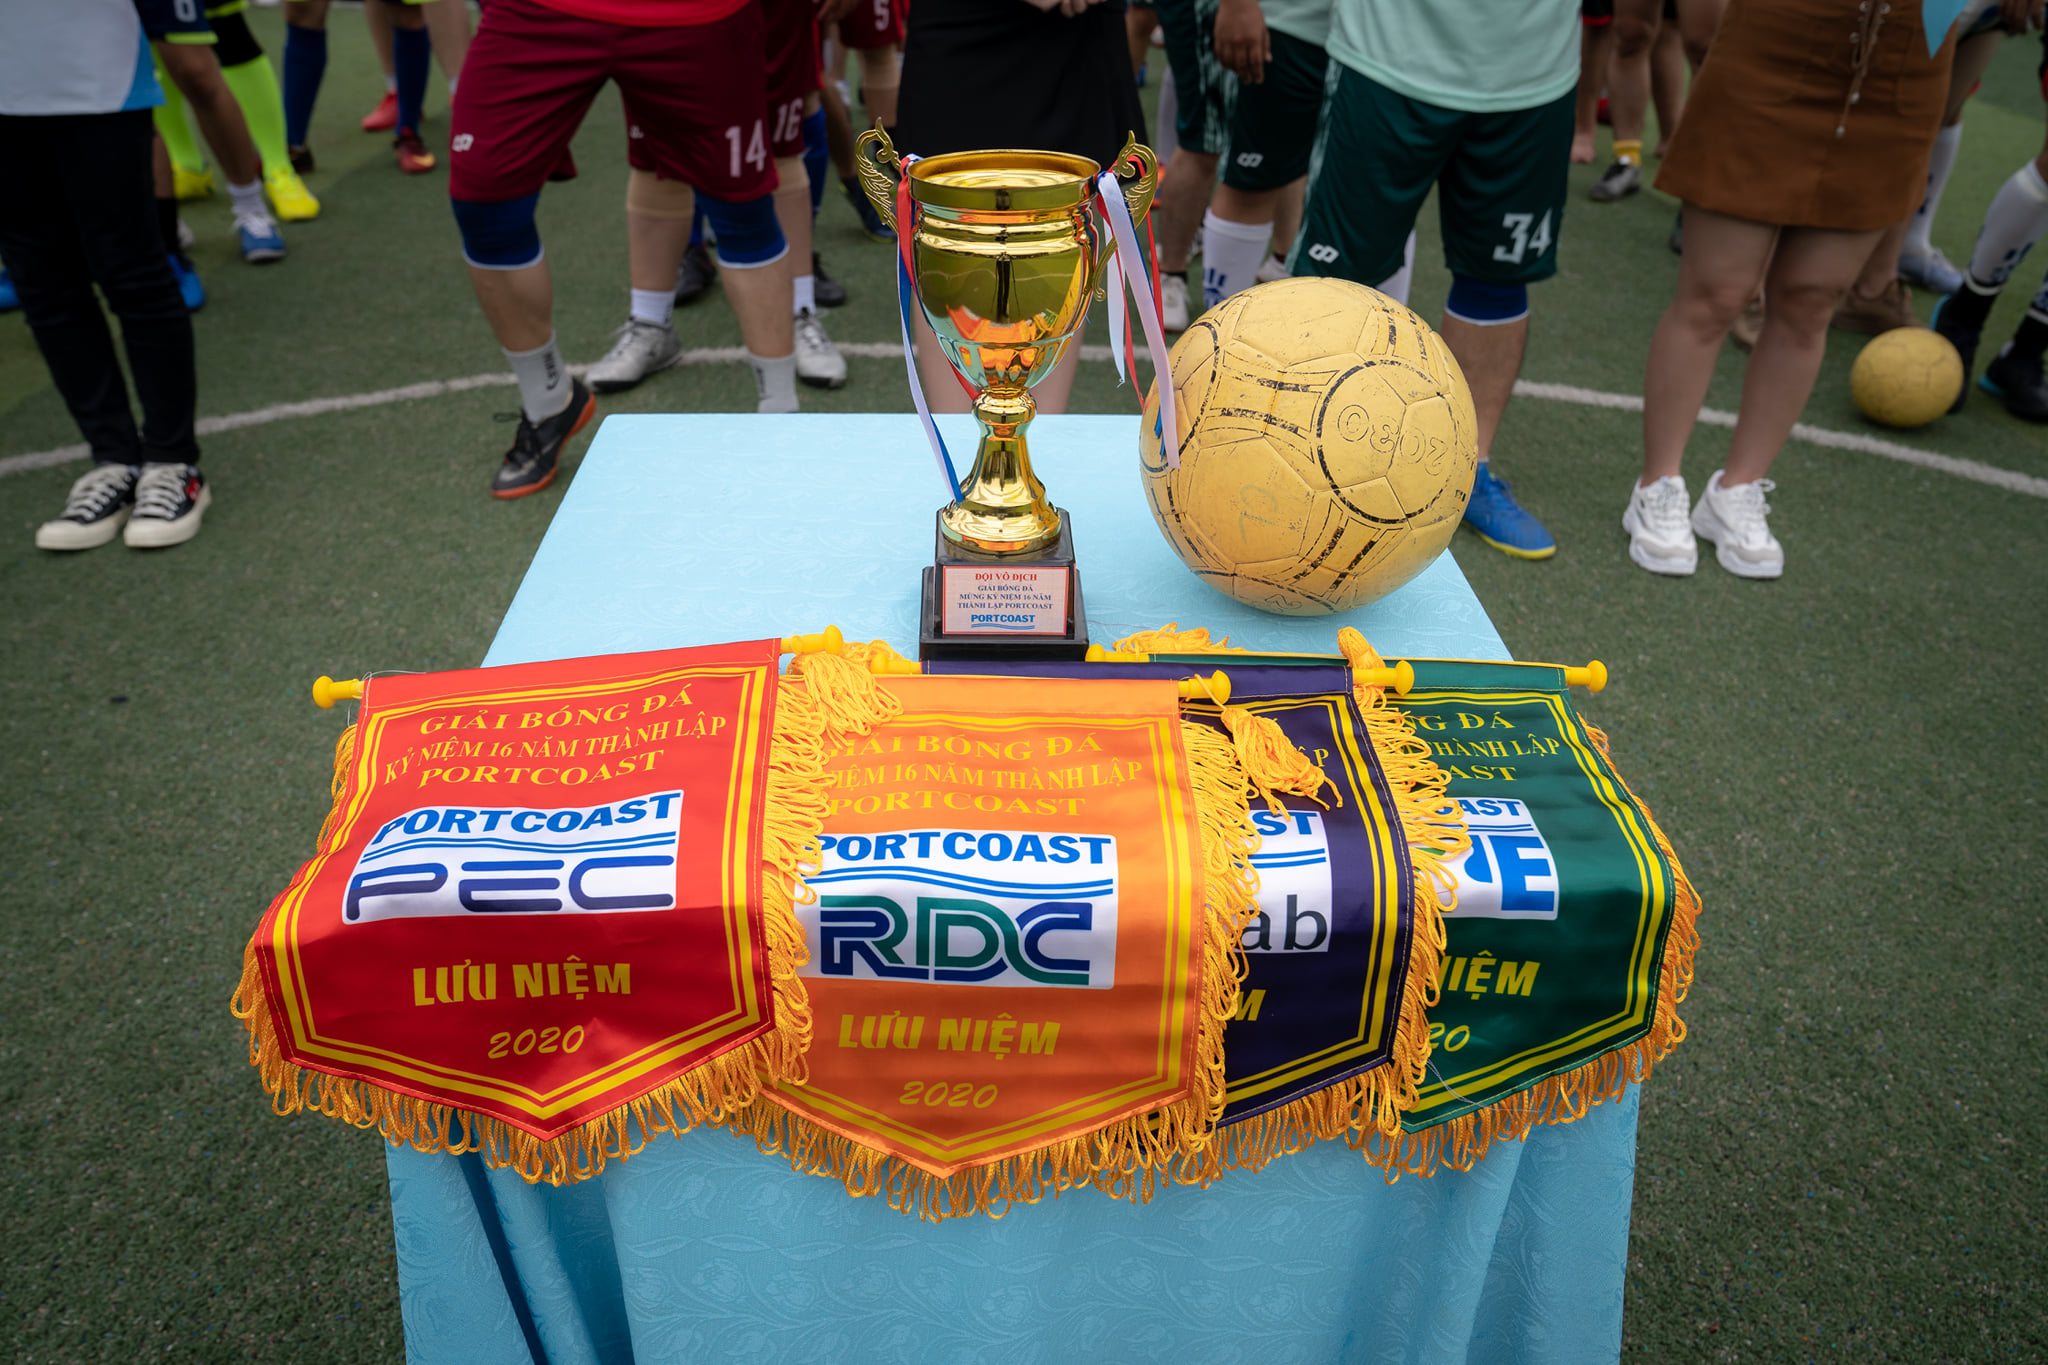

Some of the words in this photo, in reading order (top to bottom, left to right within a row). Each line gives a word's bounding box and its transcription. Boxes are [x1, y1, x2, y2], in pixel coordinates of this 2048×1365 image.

[773, 97, 802, 142] 16
[725, 119, 767, 178] 14
[1493, 207, 1552, 265] 34
[975, 573, 993, 582] ĐỘI
[996, 571, 1010, 581] VÔ
[1012, 573, 1038, 582] ĐỊCH
[997, 584, 1020, 592] BÓNG
[957, 601, 986, 609] THÀNH
[987, 602, 1005, 610] LẬP
[1005, 602, 1054, 610] PORTCOAST
[1000, 593, 1021, 602] NIỆM
[1032, 593, 1052, 601] NĂM
[971, 614, 1036, 623] PORTCOAST
[420, 709, 510, 734] GIẢI
[517, 703, 630, 729] BÓNG
[640, 683, 694, 714] ĐÁ
[1456, 711, 1516, 729] ĐÁ
[384, 747, 415, 785] KỶ
[417, 736, 484, 767] NIỆM
[489, 742, 515, 757] 16
[517, 736, 579, 758] NĂM
[585, 721, 670, 756] THÀNH
[675, 711, 726, 739] LẬP
[915, 734, 1033, 760] BÓNG
[1045, 732, 1103, 757] ĐÁ
[1512, 733, 1560, 757] LẬP
[417, 749, 664, 789] PORTCOAST
[829, 764, 886, 791] IỆM
[893, 763, 918, 782] 16
[924, 762, 984, 786] NĂM
[992, 767, 1085, 790] THÀNH
[1090, 757, 1142, 787] LẬP
[371, 792, 682, 845] PORTCOAST
[830, 791, 1086, 816] PORTCOAST
[345, 855, 675, 921] PEC
[820, 895, 1093, 986] RDC
[413, 959, 497, 1006] LƯU
[512, 954, 631, 1000] NIỆM
[487, 1025, 585, 1059] 2020
[838, 1010, 925, 1049] LƯU
[938, 1012, 1061, 1060] NIỆM
[899, 1081, 998, 1109] 2020
